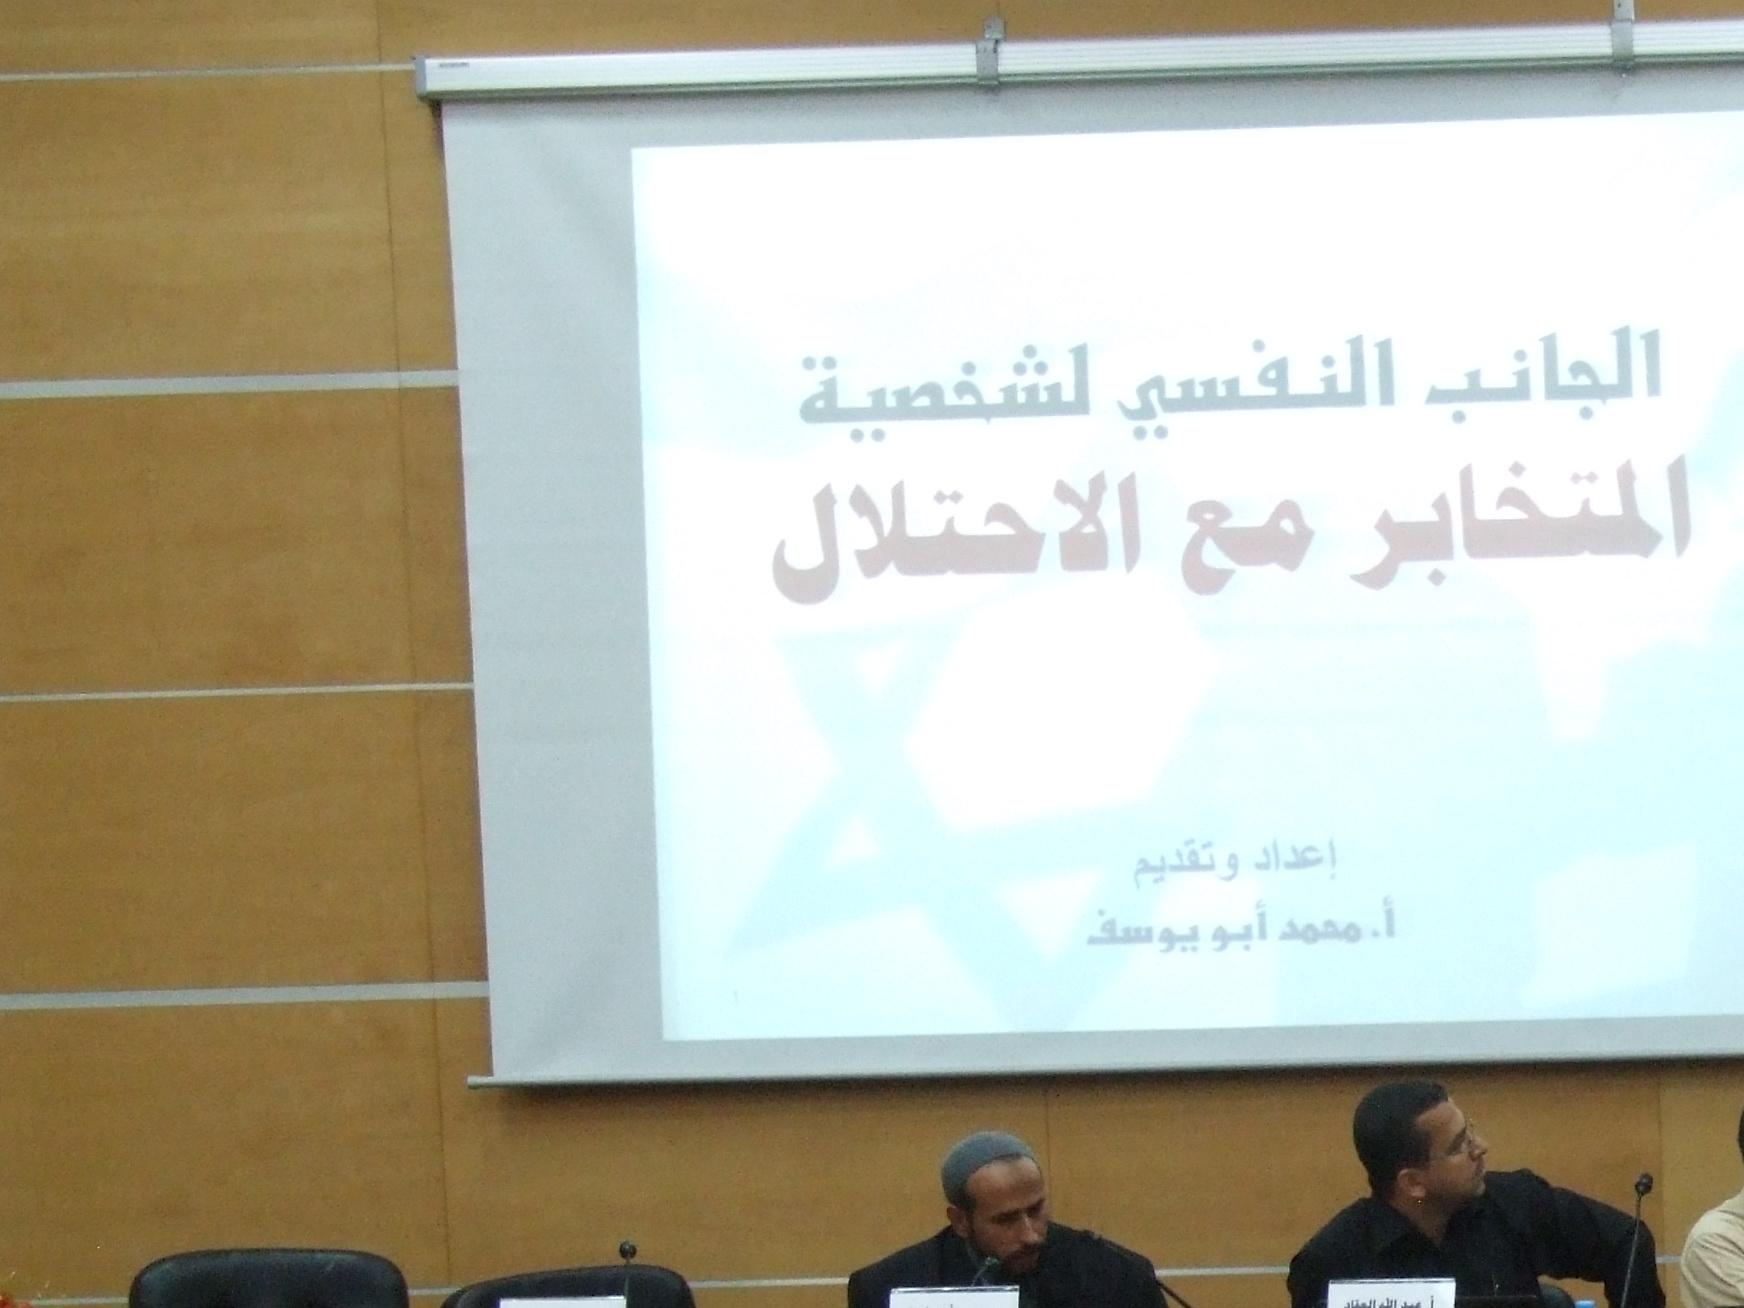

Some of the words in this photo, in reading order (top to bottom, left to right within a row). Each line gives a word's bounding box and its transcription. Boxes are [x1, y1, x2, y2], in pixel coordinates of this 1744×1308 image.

[798, 341, 1091, 443] لشخصية
[1115, 333, 1396, 440] النفسي
[1425, 325, 1662, 424] الجانب
[772, 468, 1140, 604] الاحتلال
[1181, 496, 1316, 596] مع
[1348, 453, 1692, 590] المتخابر
[1252, 837, 1338, 881] إعداد
[1085, 908, 1201, 954] يوسف
[1209, 898, 1268, 952] أبو
[1278, 911, 1362, 946] محمد
